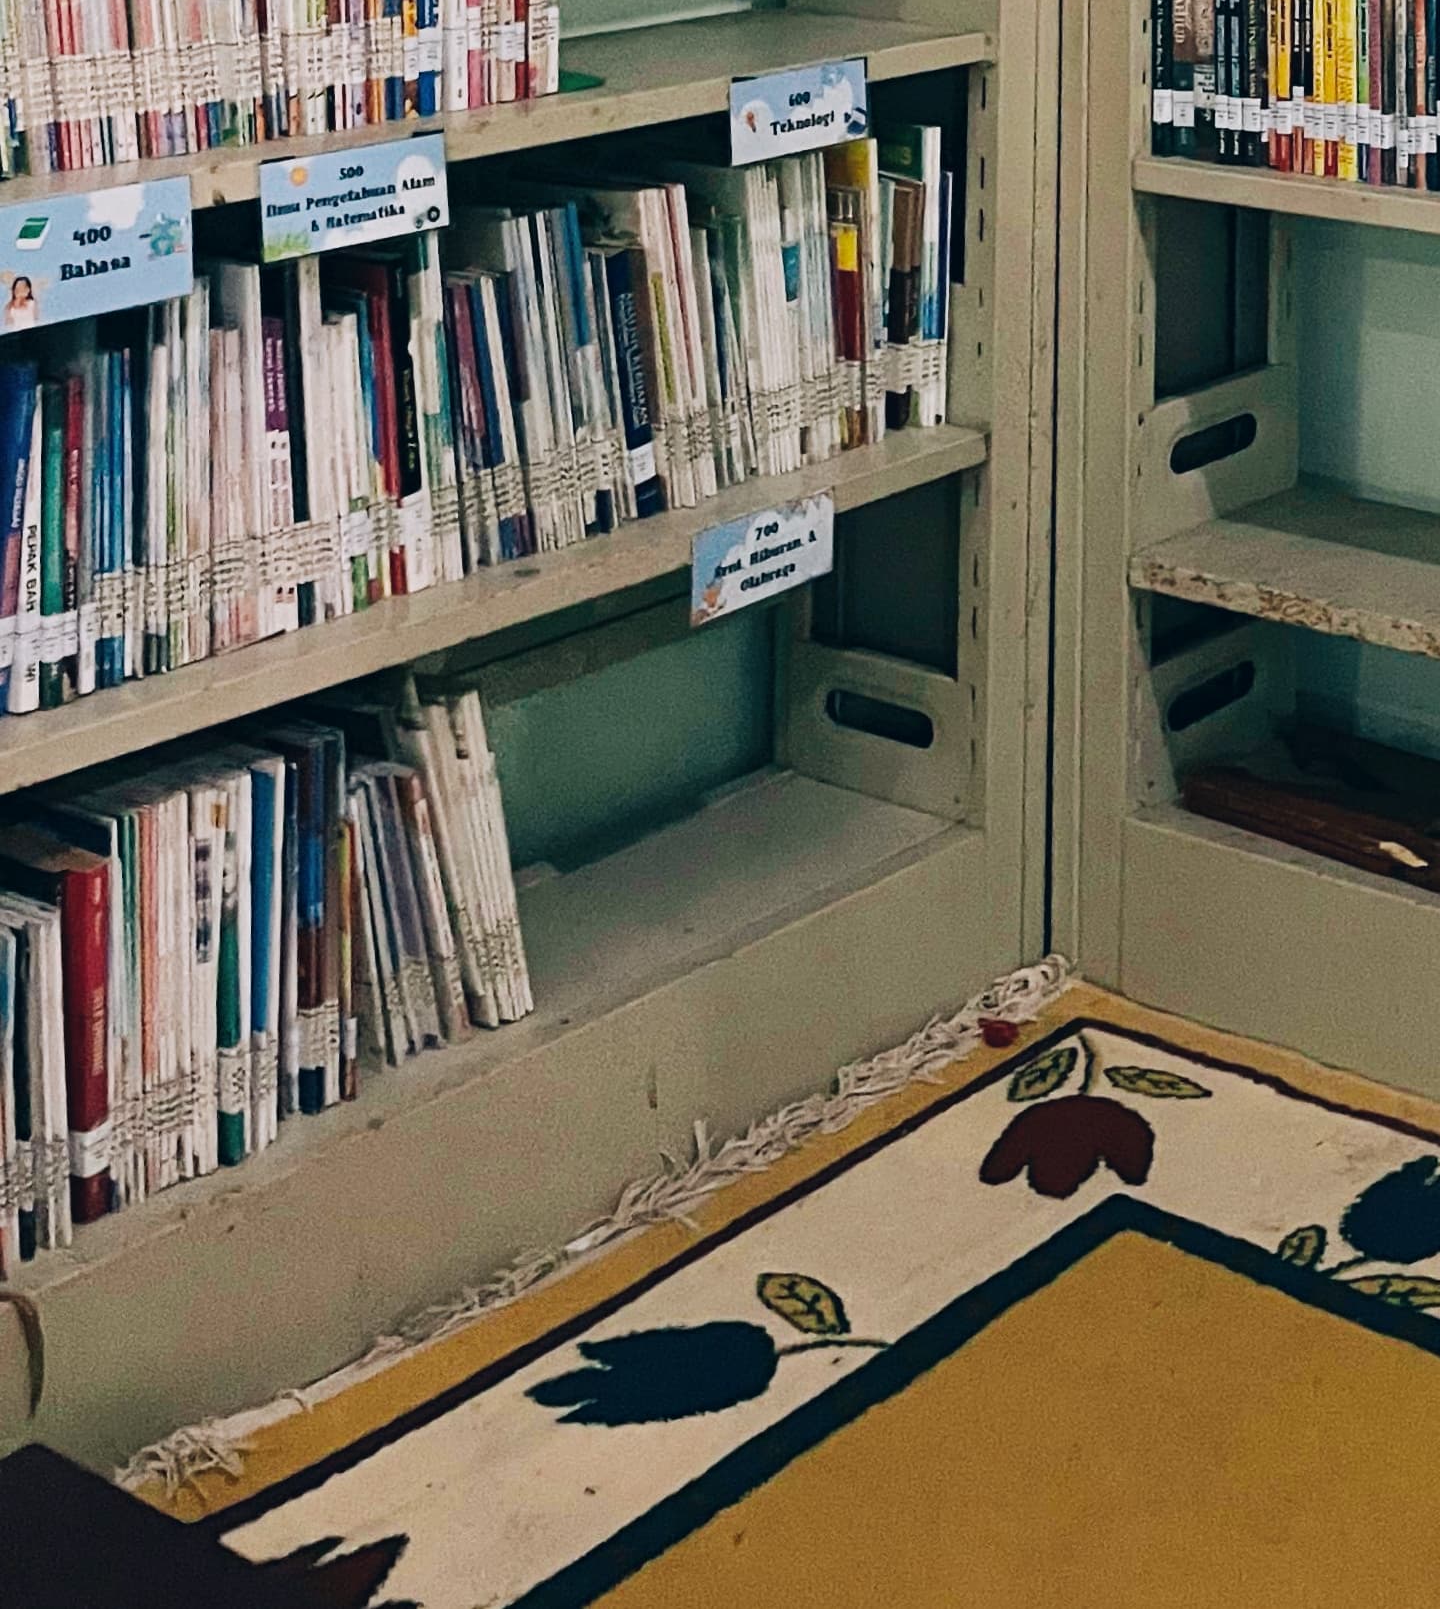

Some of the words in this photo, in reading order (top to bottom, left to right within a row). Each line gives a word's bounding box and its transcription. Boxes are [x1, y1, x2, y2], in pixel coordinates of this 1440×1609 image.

[788, 91, 811, 107] 600
[770, 110, 835, 136] Teknologi
[339, 165, 364, 181] 500
[266, 202, 301, 218] Ilmu
[306, 183, 396, 211] Pengetahuan
[402, 176, 435, 191] Alam
[326, 204, 405, 230] Matematika
[72, 225, 112, 246] 400
[59, 255, 131, 282] Bahasa
[754, 521, 779, 541] 700
[740, 563, 796, 592] Olahraga
